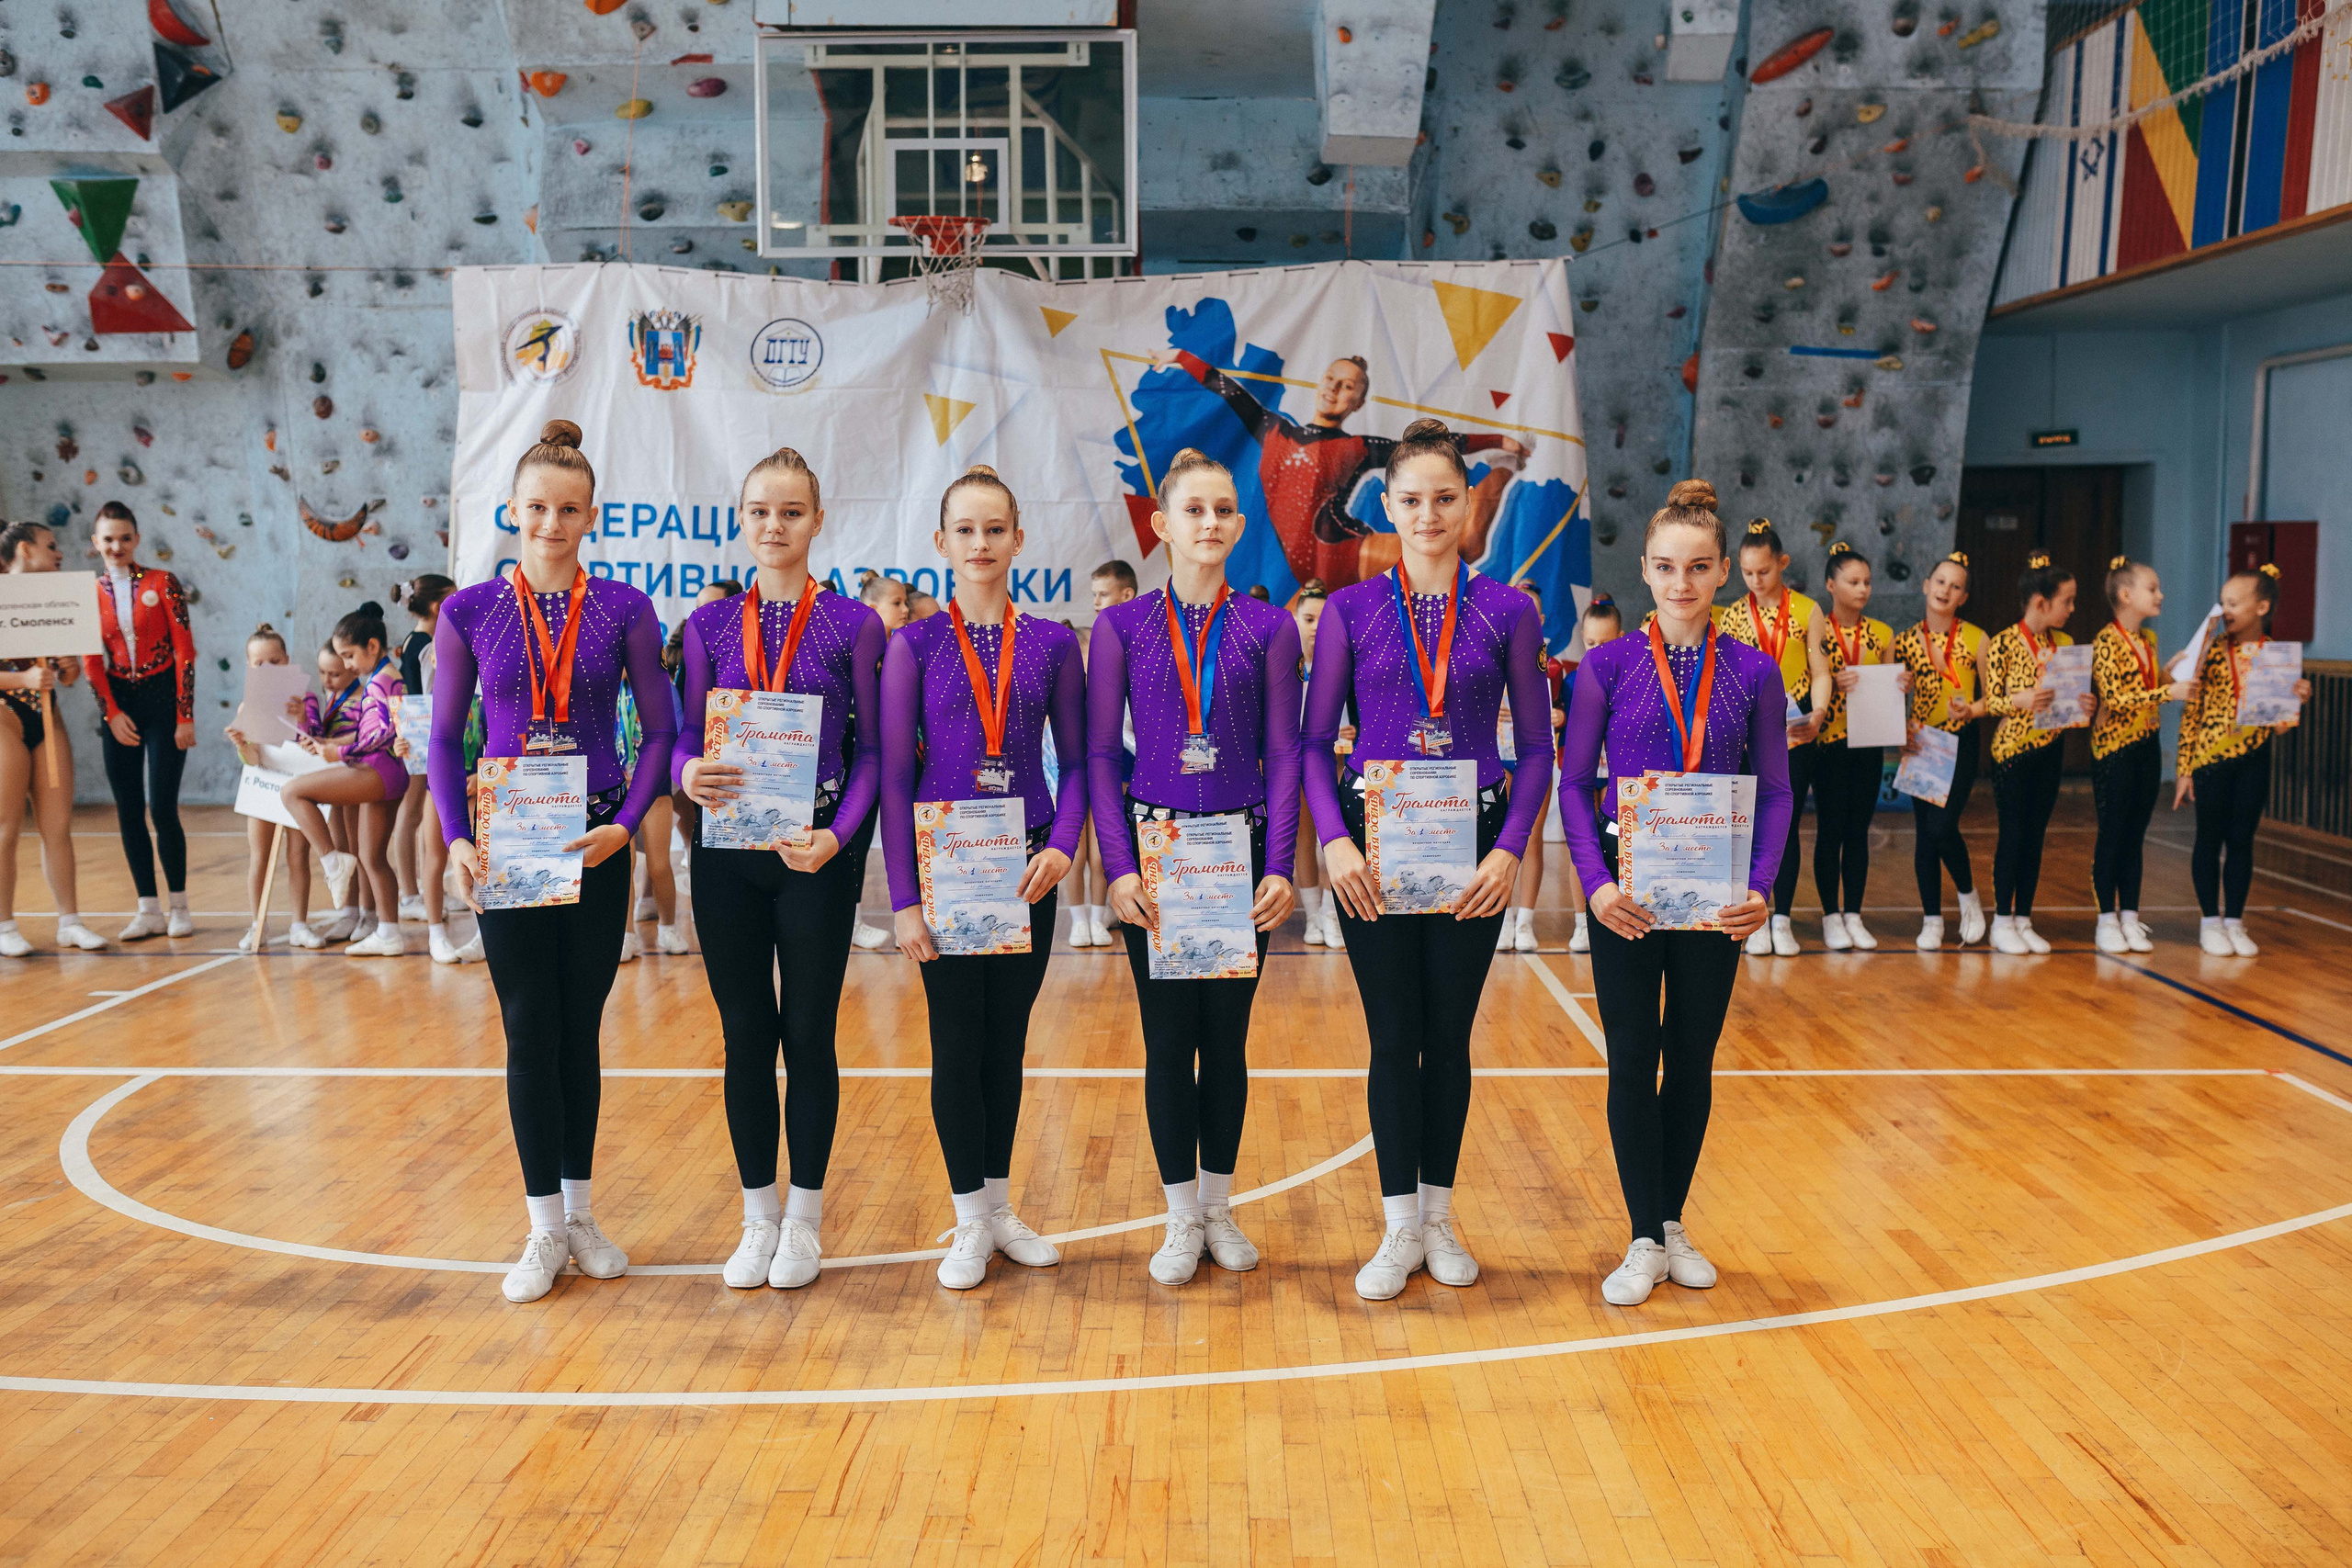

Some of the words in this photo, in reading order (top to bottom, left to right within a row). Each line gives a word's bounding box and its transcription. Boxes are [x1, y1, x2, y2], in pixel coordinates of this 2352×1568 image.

[763, 338, 810, 365] ДГТУ
[10, 616, 74, 628] Смоленск
[712, 723, 723, 760] ОСЕНЬ
[736, 721, 814, 748] Грамота
[746, 756, 757, 766] За
[770, 761, 798, 769] место
[254, 776, 281, 793] Росто
[481, 793, 492, 829] ОСЕНЬ
[504, 788, 581, 814] Грамота
[1370, 795, 1379, 833] ОСЕНЬ
[1391, 791, 1469, 818] Грамота
[515, 822, 526, 832] За
[1405, 826, 1416, 836] За
[1429, 827, 1457, 835] место
[1623, 811, 1633, 848] ОСЕНЬ
[1645, 808, 1724, 834] Грамота
[922, 837, 932, 873] ОСЕНЬ
[943, 830, 1020, 858] Грамота
[1658, 841, 1670, 852] За
[480, 833, 490, 884] ОНСКАЯ
[956, 865, 967, 875] За
[980, 866, 1008, 874] место
[1170, 857, 1247, 884] Грамота
[1148, 862, 1159, 898] ОСЕНЬ
[924, 876, 937, 929] ДОНСКАЯ
[1183, 891, 1194, 900] За
[1150, 902, 1162, 953] ДОНСЯ
